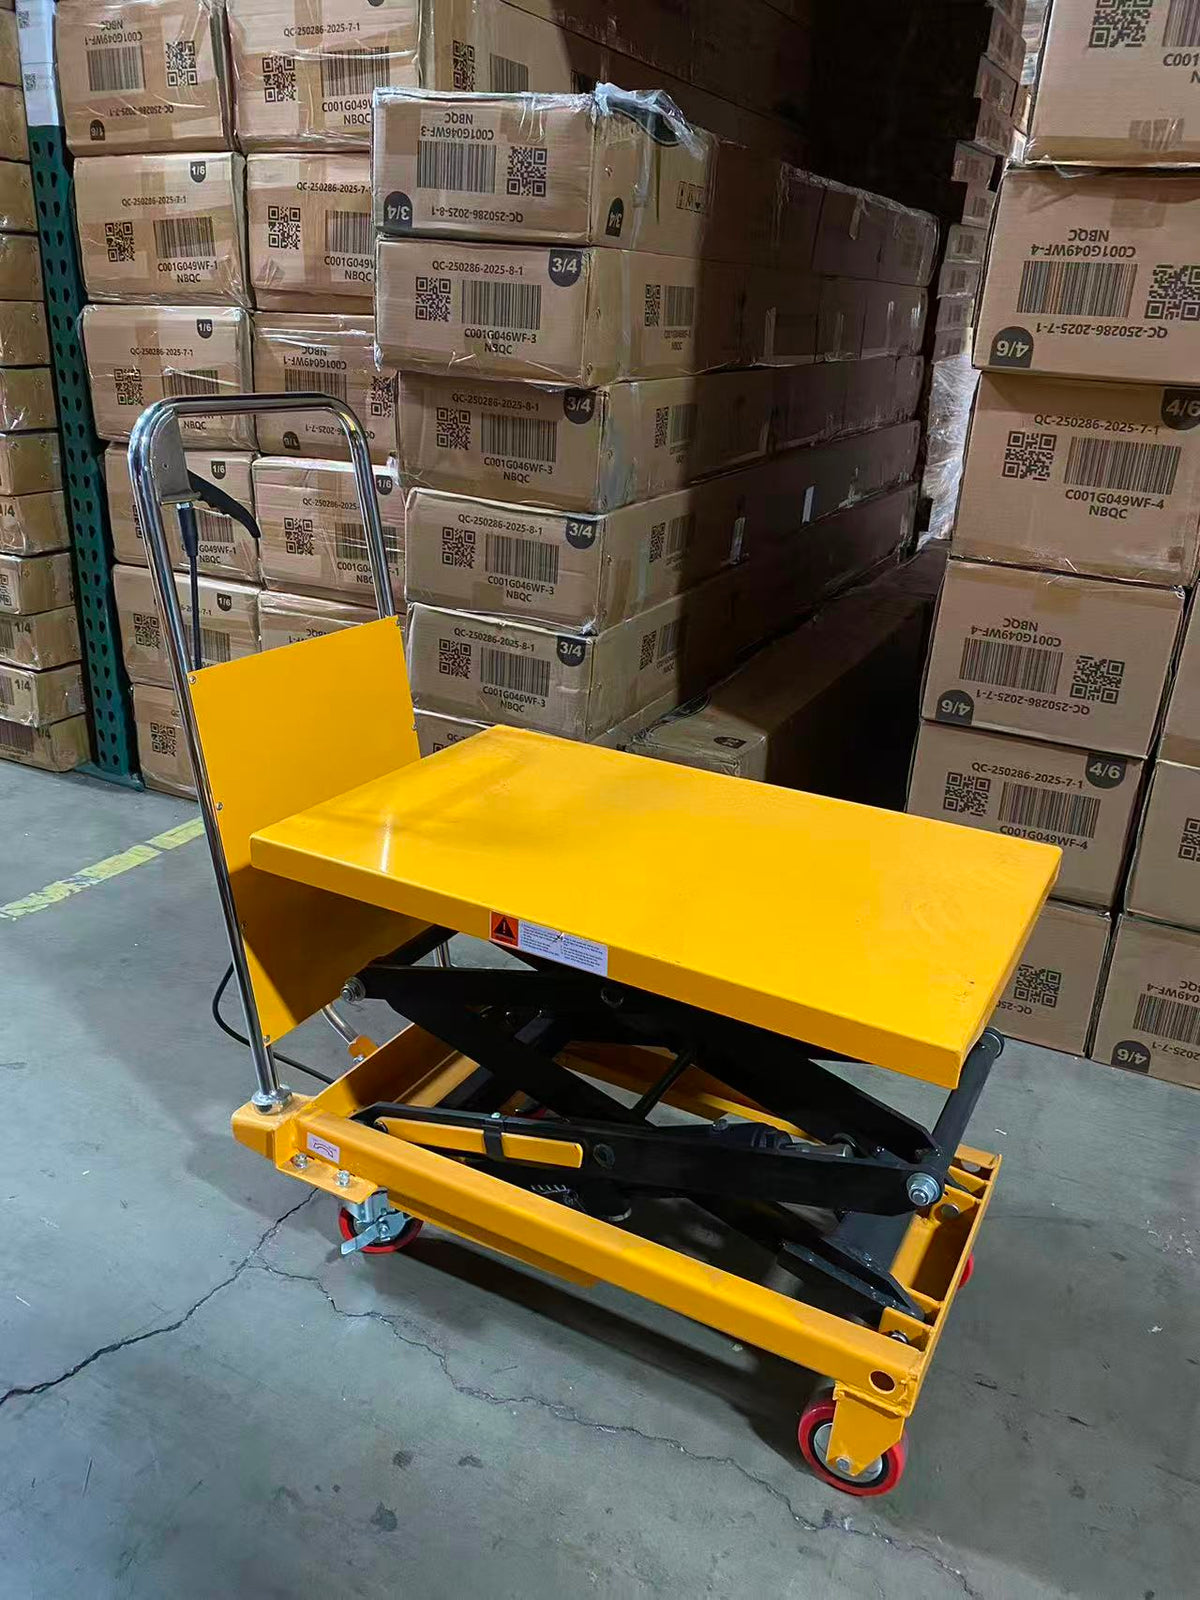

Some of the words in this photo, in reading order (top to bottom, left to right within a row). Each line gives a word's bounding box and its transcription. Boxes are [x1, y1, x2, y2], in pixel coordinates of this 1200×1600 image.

[283, 22, 361, 37] QC-250286-2025-7-1
[343, 113, 371, 125] NBQC
[445, 112, 473, 125] NBQC
[420, 125, 494, 140] C001G046WF-3
[192, 166, 206, 176] 1/6
[387, 205, 410, 221] 3/4
[431, 208, 524, 223] QC-250286-2025-8-1
[1068, 229, 1109, 242] NBQC
[1031, 243, 1136, 258] C001G049WF-4
[157, 261, 218, 272] C001G049WF-1
[432, 260, 524, 276] QC-250286-2025-8-1
[552, 257, 578, 274] 3/4
[177, 273, 201, 283] NBQC
[344, 270, 372, 282] NBQC
[198, 322, 212, 332] 1/6
[1036, 322, 1168, 339] QC-250286-2025-7-1
[464, 328, 537, 344] C001G046WF-3
[484, 342, 513, 355] NBQC
[996, 340, 1030, 357] 4/6
[451, 392, 540, 412] QC-250286-2025-8-1
[566, 397, 591, 413] 3/4
[1165, 400, 1200, 417] 4/6
[183, 421, 207, 430] NBQC
[1034, 414, 1160, 435] QC-250286-2025-7-1
[212, 465, 225, 473] 1/6
[483, 456, 553, 475] C001G046WF-3
[377, 479, 392, 490] 1/6
[503, 471, 530, 484] NBQC
[302, 498, 360, 510] QC-250286-2025-
[1065, 489, 1164, 510] C001G049WF-4
[1088, 505, 1128, 520] NBQC
[458, 513, 543, 536] QC-250286-2025-8-1
[569, 522, 592, 539] 3/4
[356, 575, 374, 585] NBQ
[487, 575, 555, 595] C001G046WF-3
[506, 589, 532, 603] NBQC
[1003, 617, 1038, 633] NBQC
[453, 627, 535, 652] QC-250286-2025-8-1
[970, 624, 1062, 648] C001G049WF-4
[559, 641, 583, 658] 3/4
[15, 680, 31, 691] 1/4
[482, 686, 546, 708] C001G046WF-3
[975, 689, 1090, 715] QC-250286-2025-7-1
[500, 700, 525, 713] NBQC
[941, 699, 971, 716] 4/6
[971, 761, 1084, 789] QC-250286-2025-7-1
[1089, 762, 1121, 779] 4/6
[999, 825, 1089, 850] C001G049WF-4
[1147, 983, 1200, 1004] 049WF-4
[1179, 980, 1200, 993] QC
[1117, 1048, 1148, 1065] 4/6
